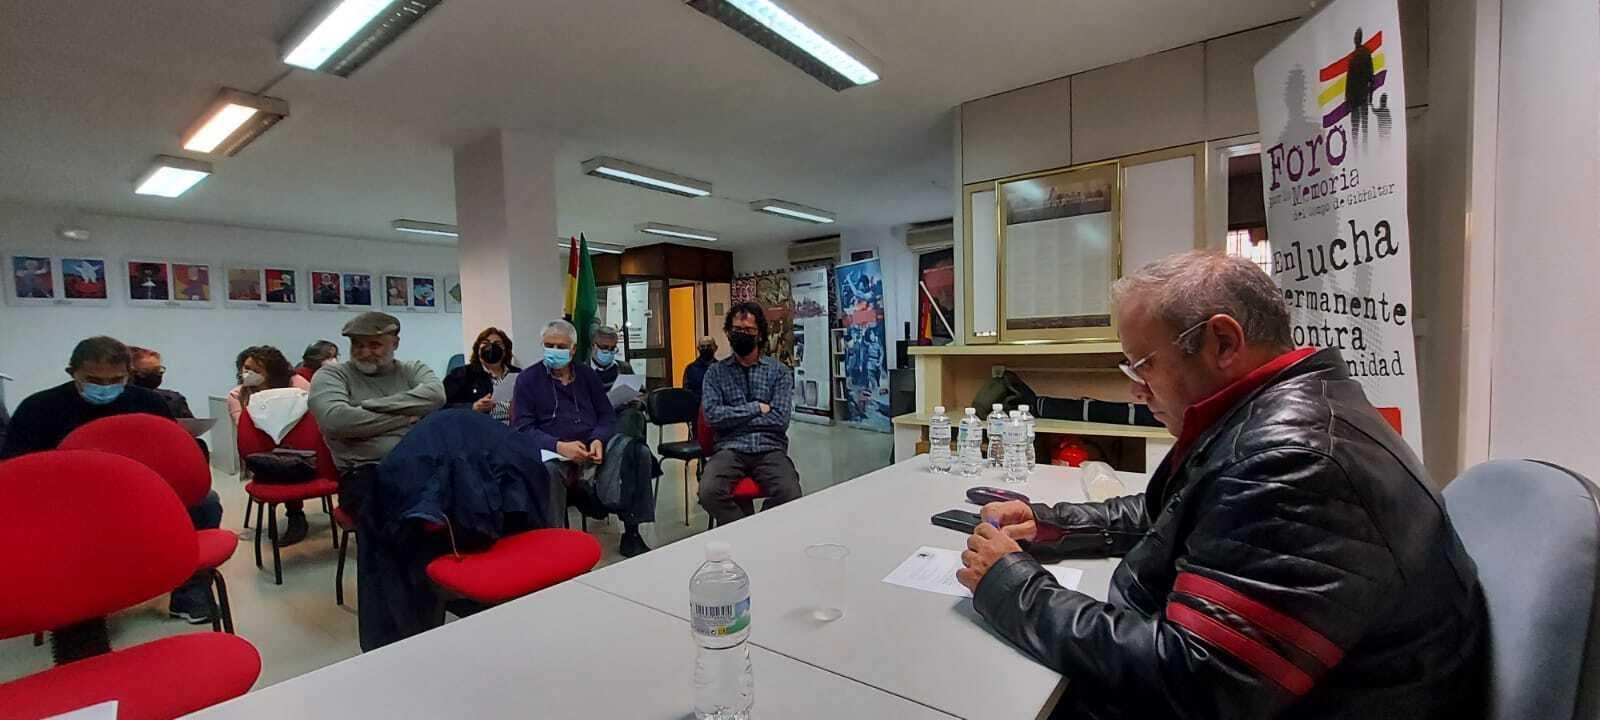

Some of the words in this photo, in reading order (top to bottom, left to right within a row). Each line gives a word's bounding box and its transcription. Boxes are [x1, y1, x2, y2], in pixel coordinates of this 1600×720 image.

[1266, 125, 1347, 191] Foro
[1332, 197, 1345, 210] de
[1273, 250, 1296, 273] En
[1291, 219, 1399, 281] lucha
[1279, 287, 1407, 326] ermanente
[1293, 319, 1367, 350] ontra
[1345, 350, 1405, 377] nidad
